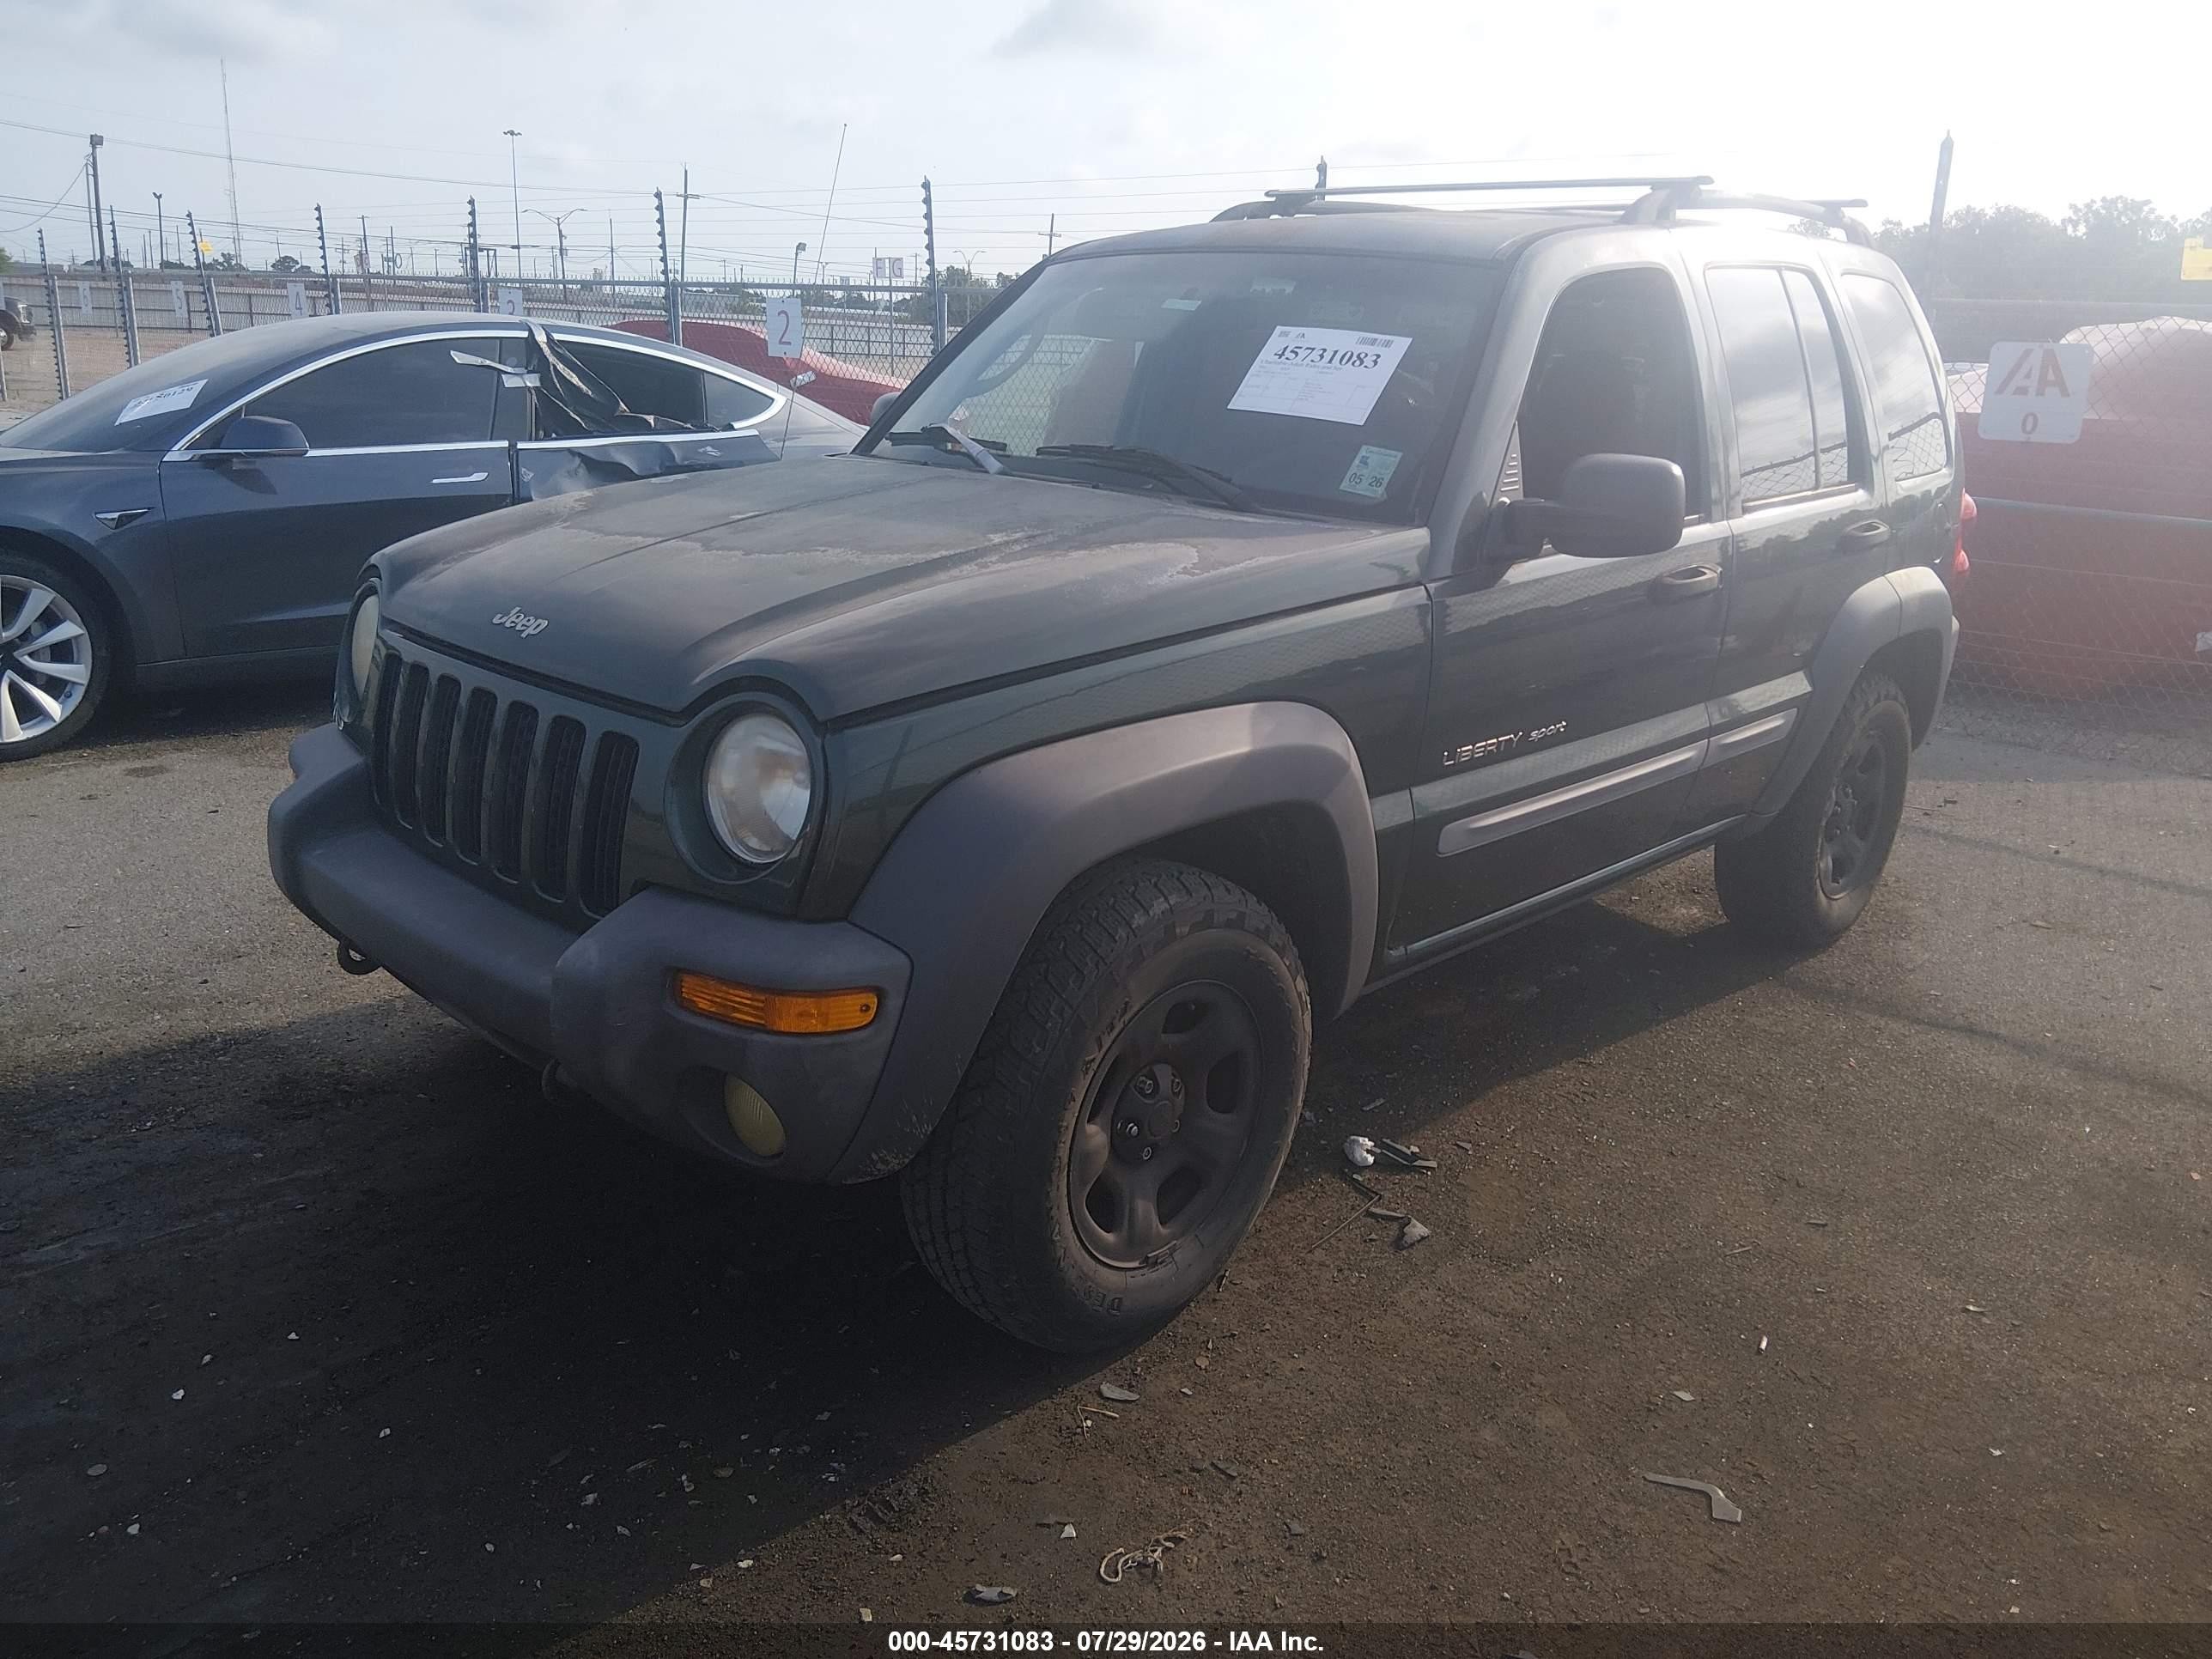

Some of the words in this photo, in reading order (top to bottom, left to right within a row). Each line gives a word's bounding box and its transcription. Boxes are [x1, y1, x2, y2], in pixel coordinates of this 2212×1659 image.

[876, 258, 883, 278] F
[892, 258, 902, 278] G
[295, 291, 303, 316] 4
[777, 310, 792, 345] 2
[1273, 344, 1382, 369] 45731083
[1348, 472, 1365, 485] 05
[1368, 475, 1384, 489] 26
[492, 606, 549, 639] Jeep
[1443, 731, 1523, 766] LIBERTY
